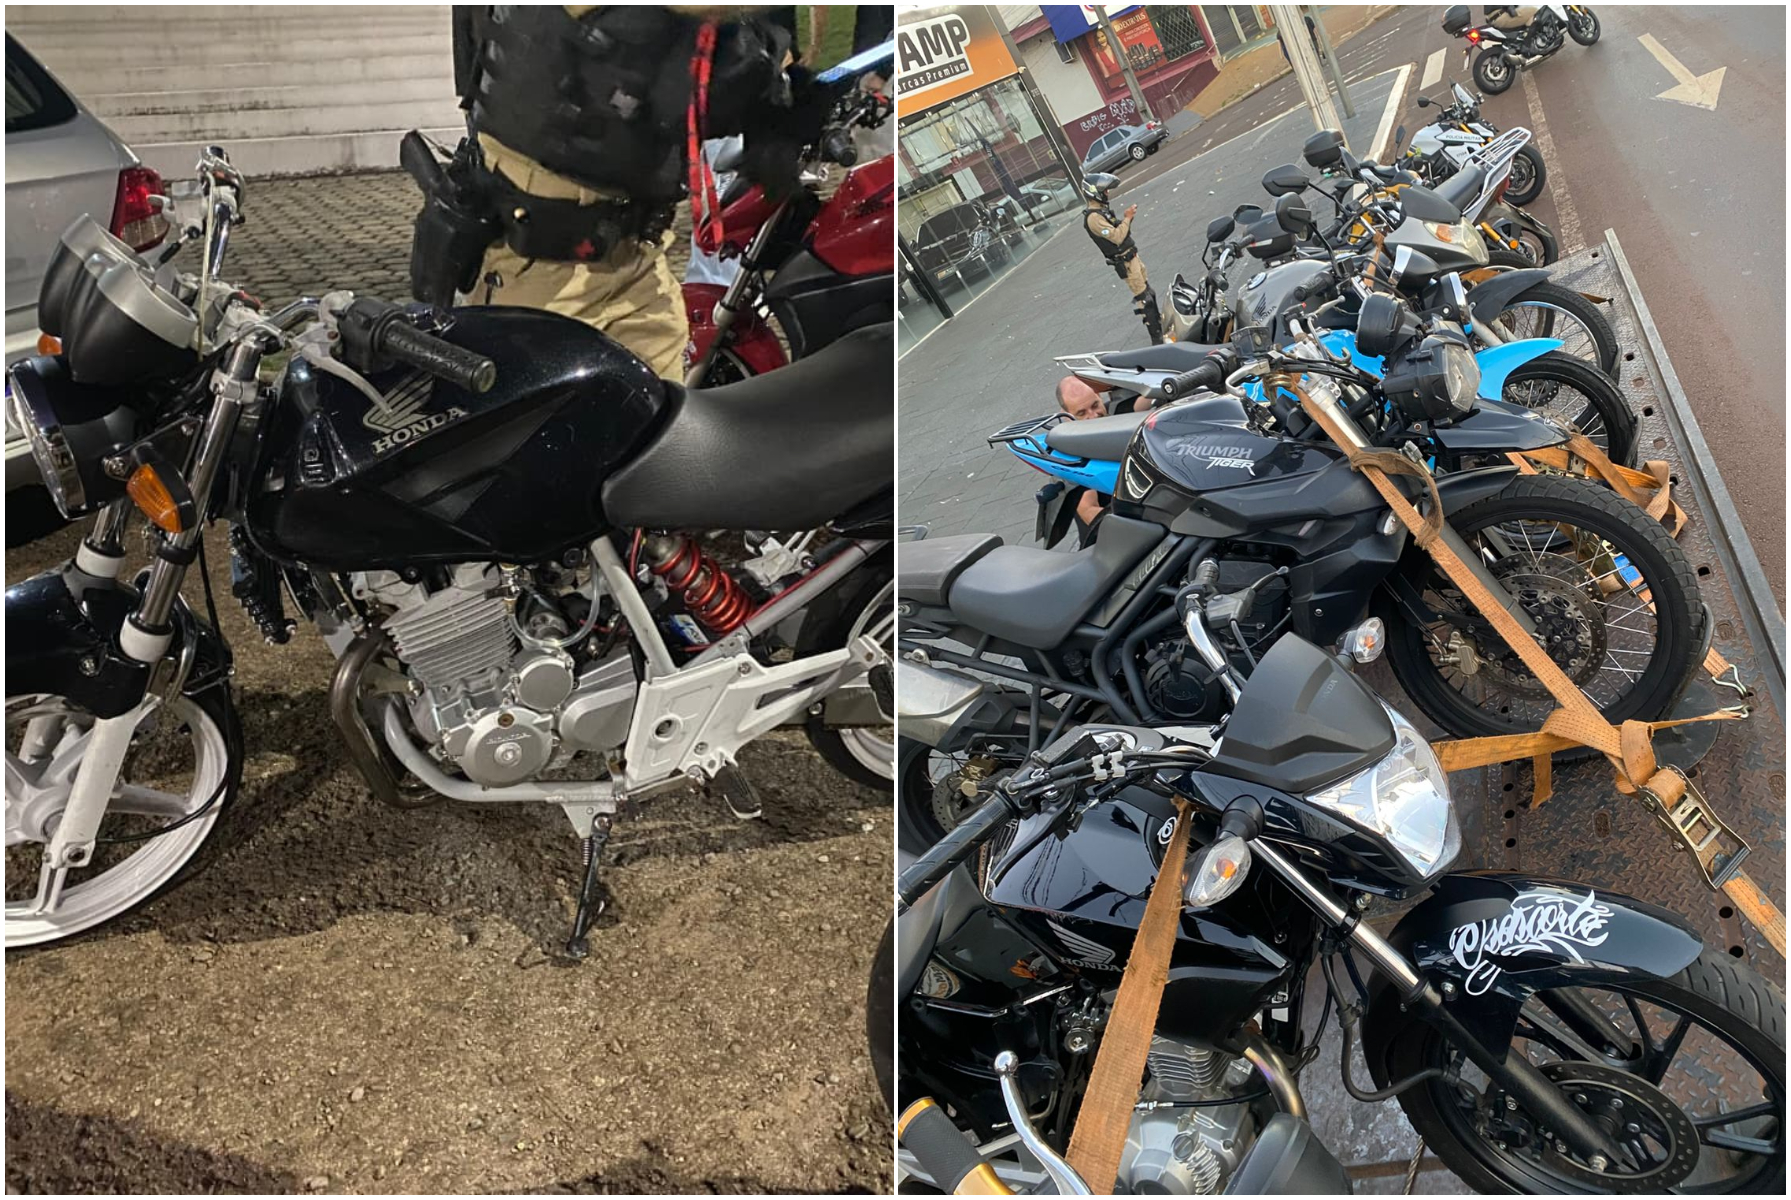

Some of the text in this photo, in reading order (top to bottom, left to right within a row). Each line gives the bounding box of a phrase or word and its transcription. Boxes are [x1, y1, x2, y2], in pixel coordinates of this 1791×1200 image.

[925, 62, 967, 82] Premium
[372, 407, 468, 454] HONDA
[1177, 444, 1253, 461] TRIUMPH
[1206, 456, 1256, 477] TIGER
[1060, 956, 1123, 973] HONDA
